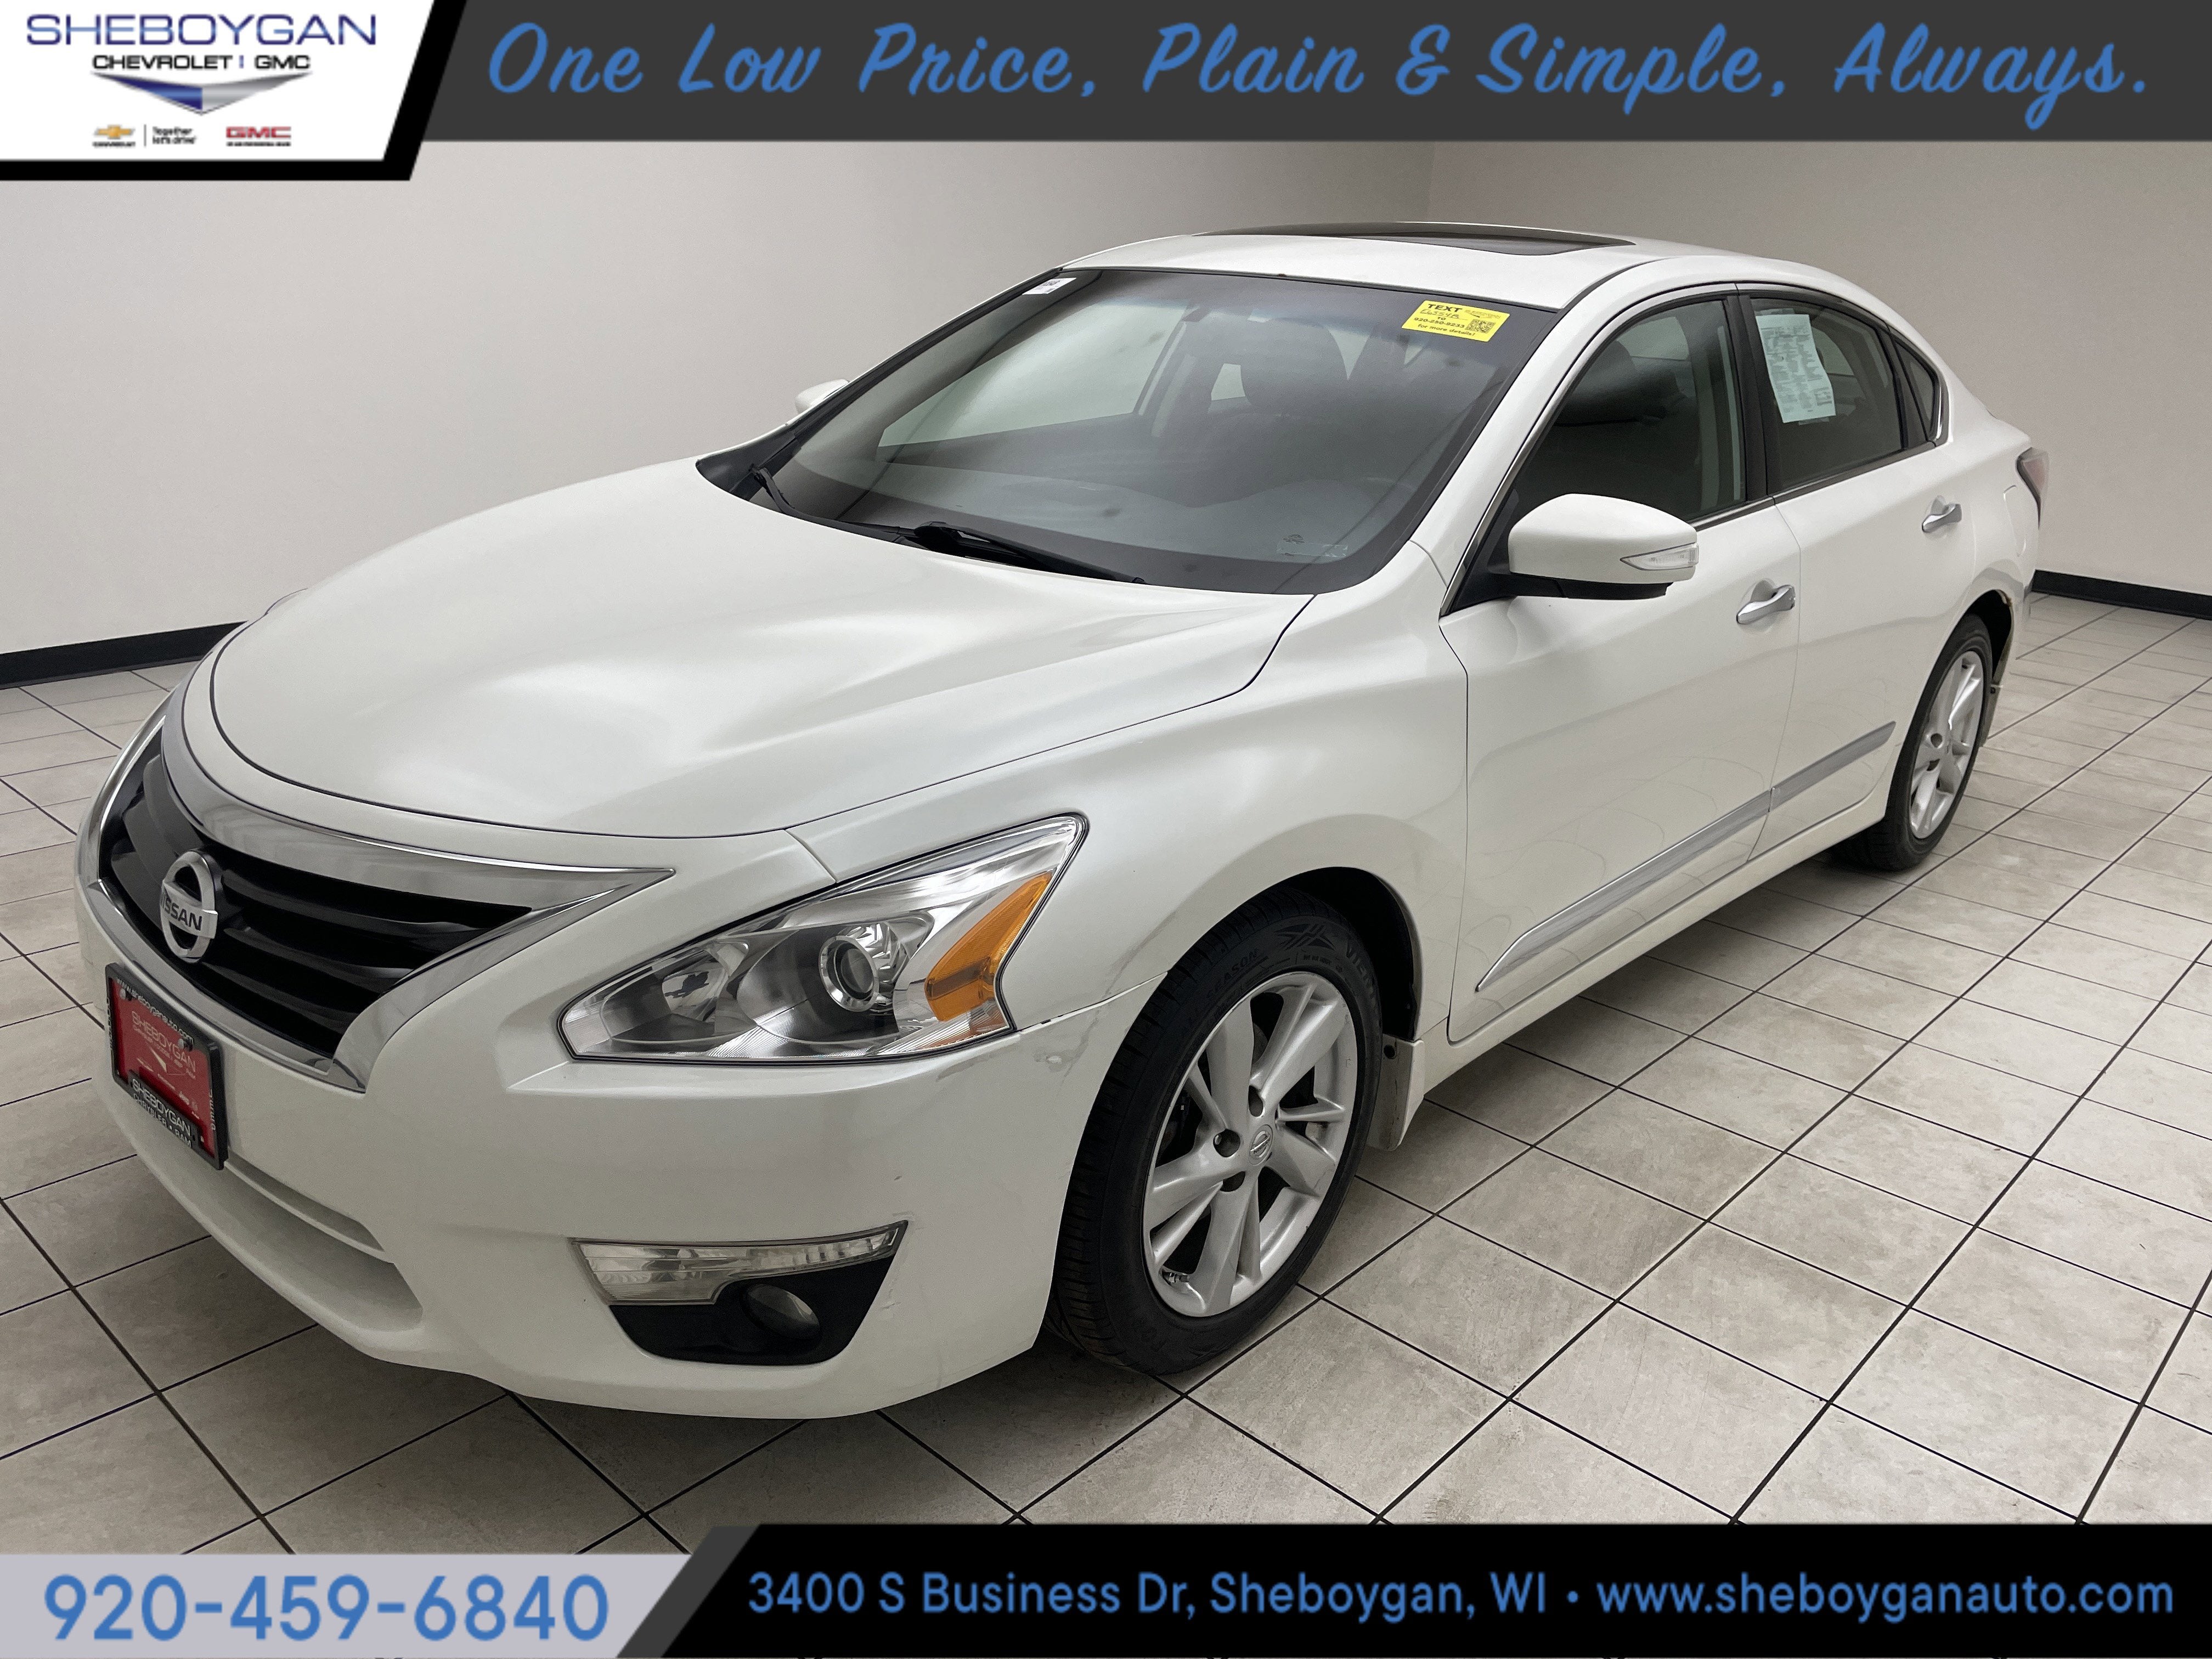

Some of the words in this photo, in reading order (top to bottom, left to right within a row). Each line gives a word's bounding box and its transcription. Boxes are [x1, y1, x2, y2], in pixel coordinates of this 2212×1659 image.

[1428, 303, 1463, 313] TEXT
[132, 1011, 196, 1073] SHEBOYGAN
[132, 1078, 191, 1137] SHEBOYGAN
[174, 1128, 192, 1148] RAM
